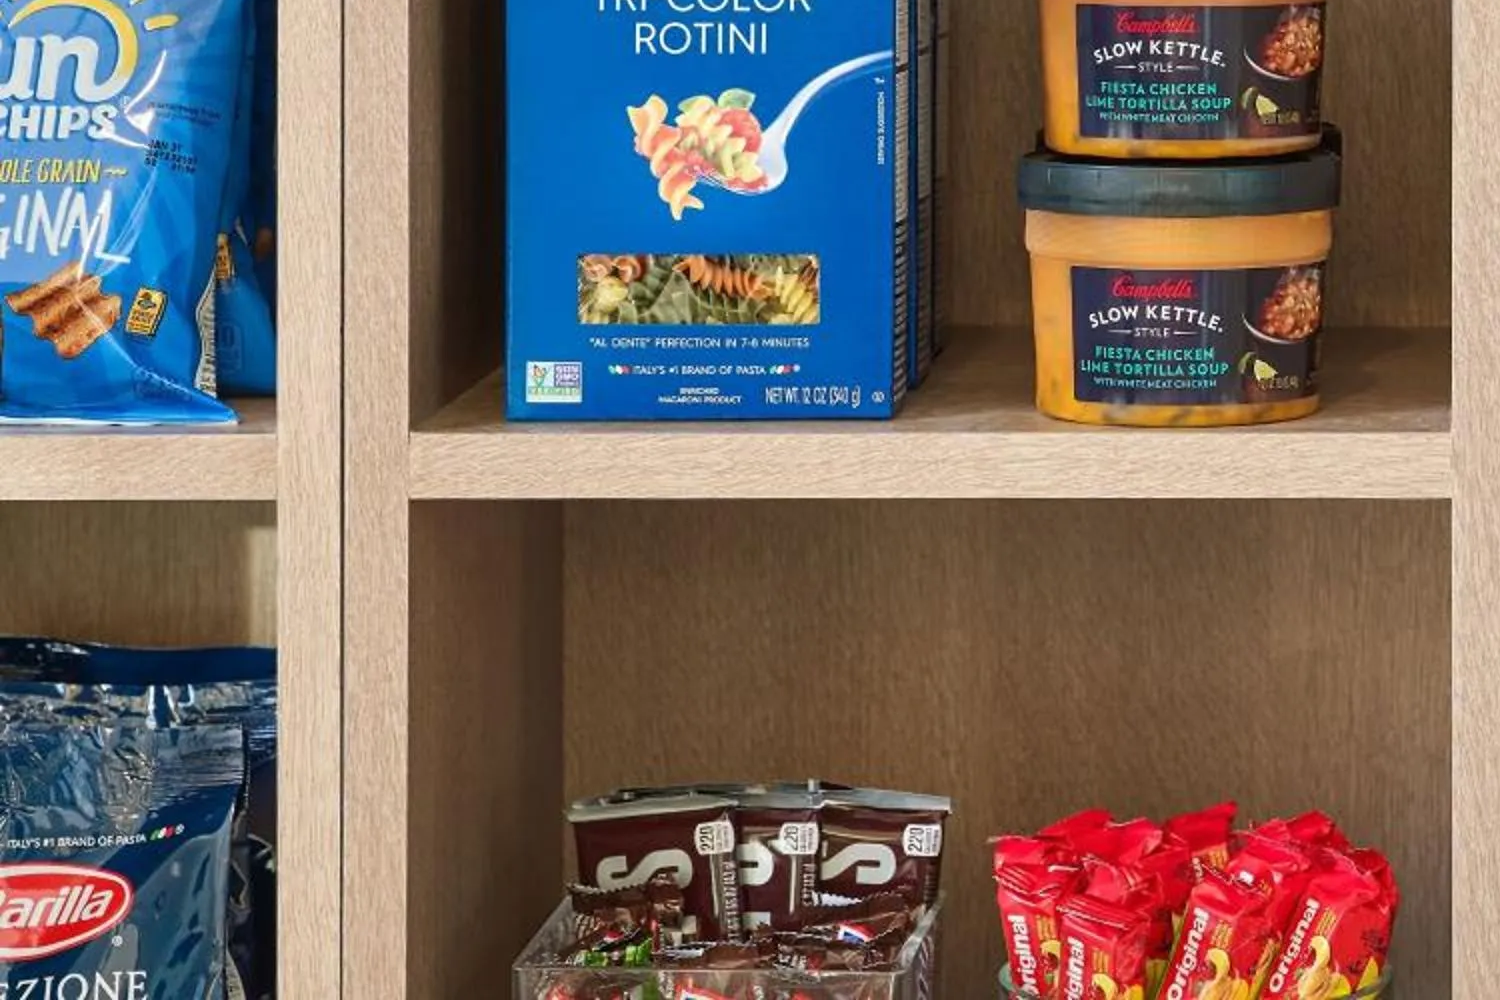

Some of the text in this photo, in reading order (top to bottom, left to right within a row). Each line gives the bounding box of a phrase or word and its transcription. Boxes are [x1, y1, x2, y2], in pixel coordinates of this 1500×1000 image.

[635, 22, 768, 55] ROTINI
[1093, 40, 1223, 66] SLOW KETTLE
[0, 33, 122, 102] un
[1138, 62, 1173, 74] STYLE
[1100, 81, 1217, 95] FIESTA CHICKEN
[1118, 95, 1188, 111] TORTILLA
[1191, 95, 1231, 110] SOUP
[0, 158, 101, 184] OLE GRAIN
[0, 187, 131, 263] INAL
[1110, 275, 1194, 298] Campbell's
[1089, 305, 1221, 331] SLOW KETTLE
[655, 337, 721, 348] PERFECTION
[726, 337, 737, 348] IN
[762, 337, 810, 348] MINUTES
[1133, 326, 1170, 338] STYLE
[1095, 346, 1215, 361] FIESTA CHICKEN
[681, 365, 717, 376] BRAND
[719, 365, 733, 376] OF
[735, 365, 767, 376] PASTA
[1115, 362, 1184, 377] TORTILLA
[1188, 362, 1229, 377] SOUP
[766, 386, 783, 402] NET
[802, 386, 813, 402] 12
[814, 386, 827, 402] OZ
[7, 838, 41, 848] ITALY'S
[58, 836, 96, 847] BRAND
[98, 836, 114, 846] OF
[115, 834, 147, 845] PASTA
[700, 825, 715, 851] 220
[784, 825, 799, 851] 220
[908, 827, 924, 852] 220
[0, 884, 114, 928] arilla
[1167, 906, 1210, 1000] Original
[1269, 898, 1321, 993] Original
